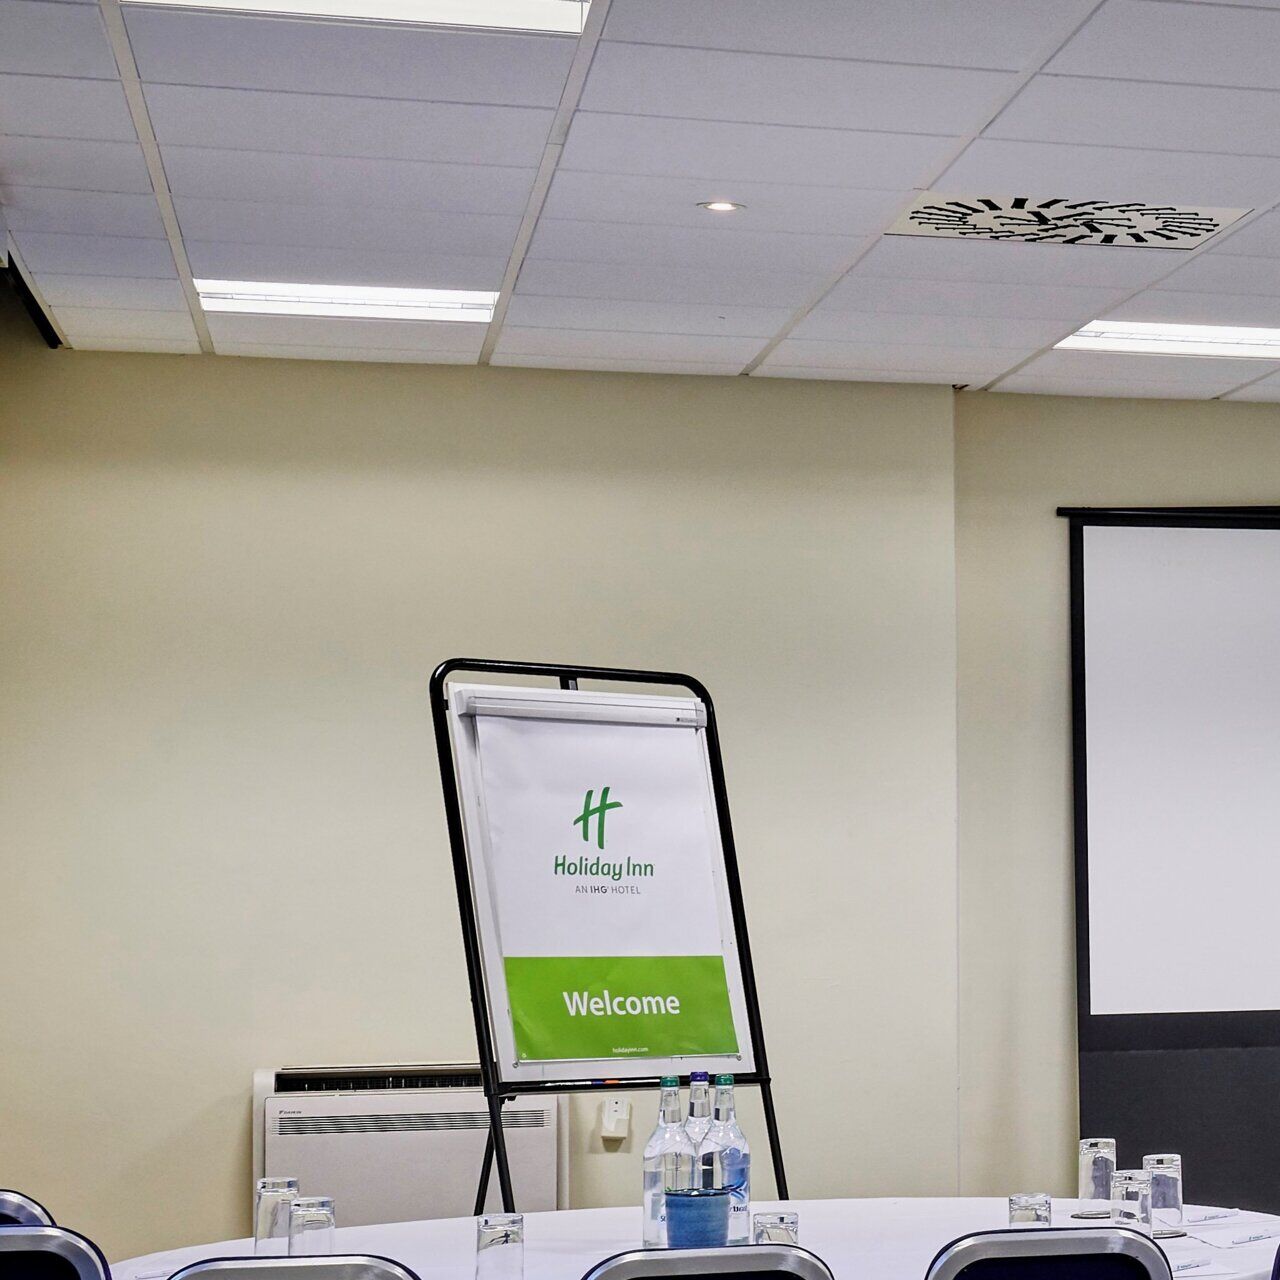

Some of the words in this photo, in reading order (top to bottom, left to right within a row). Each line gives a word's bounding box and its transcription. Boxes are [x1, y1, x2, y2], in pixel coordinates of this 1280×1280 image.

[554, 855, 623, 881] Holiday
[626, 856, 654, 877] Inn
[575, 885, 588, 894] AN
[611, 885, 641, 895] HOTEL
[562, 990, 681, 1017] Welcome
